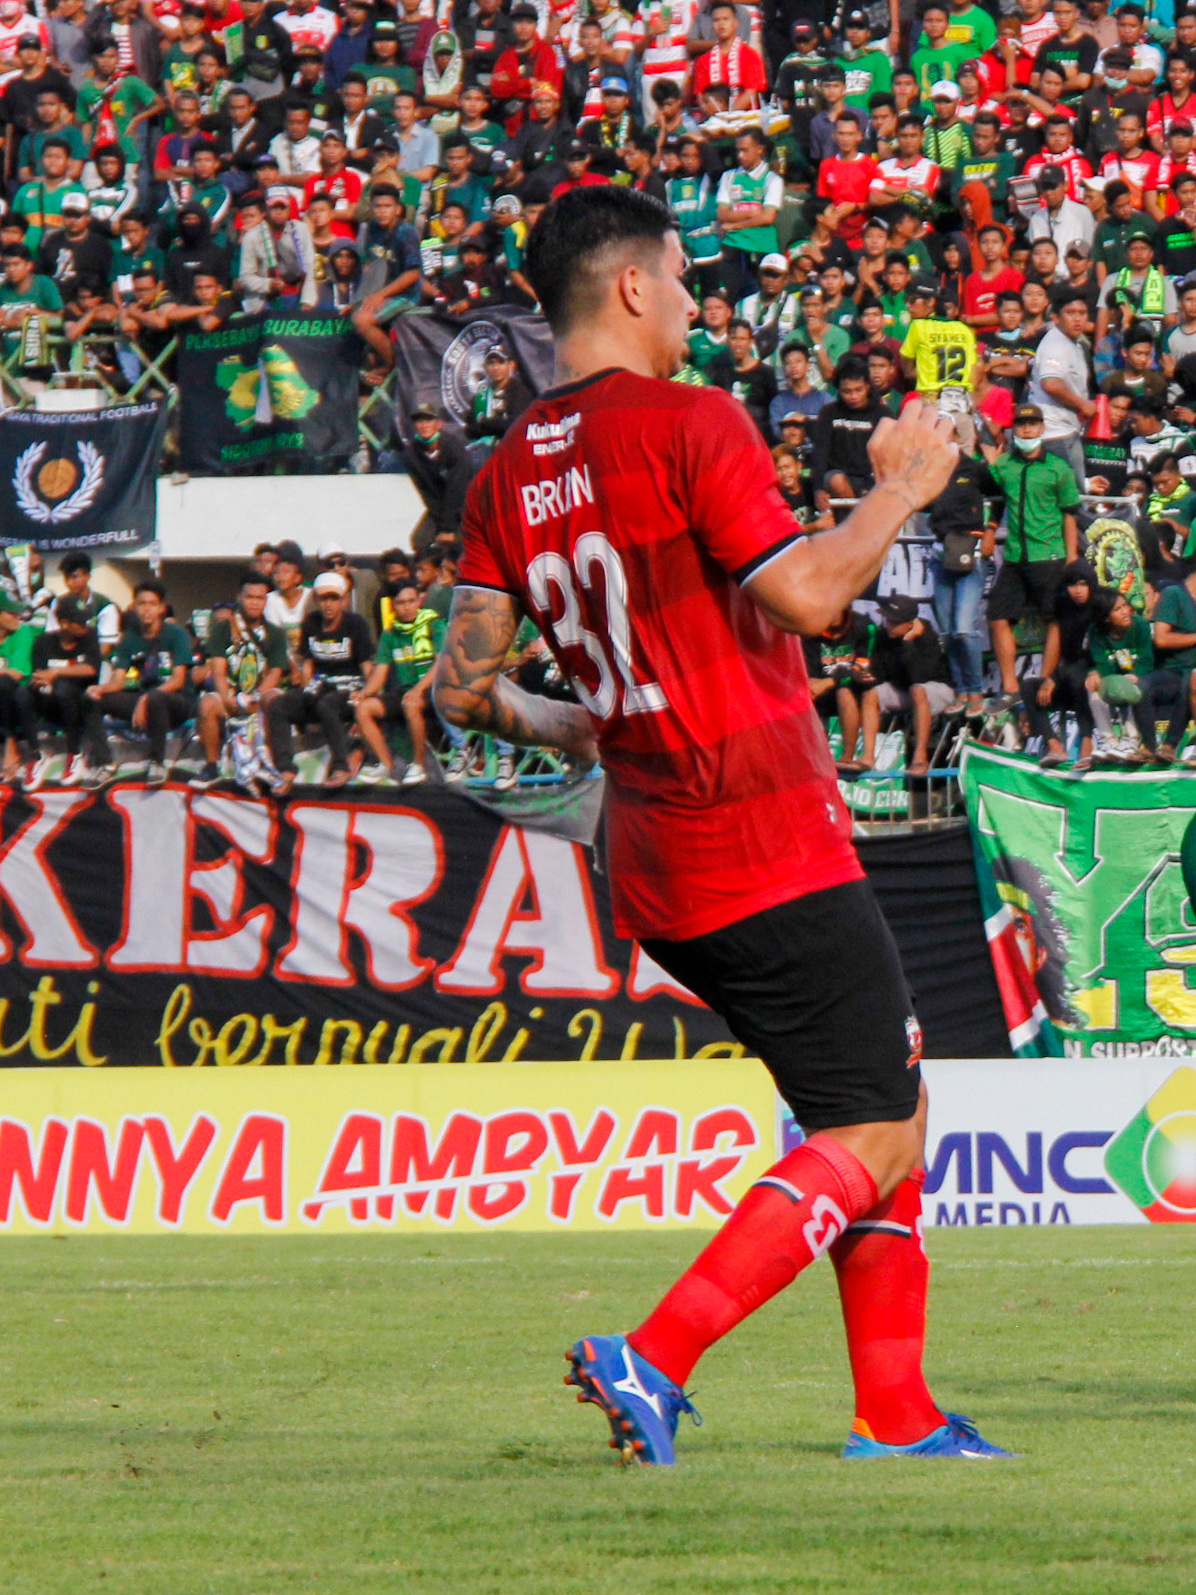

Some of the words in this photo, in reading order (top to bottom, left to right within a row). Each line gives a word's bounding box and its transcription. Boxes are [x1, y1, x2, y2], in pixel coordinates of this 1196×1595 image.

[933, 346, 966, 382] 12
[100, 402, 158, 420] FOOTBALL
[51, 529, 138, 549] WONDERFULL
[526, 531, 670, 721] 32
[302, 1104, 758, 1227] AMBYAR
